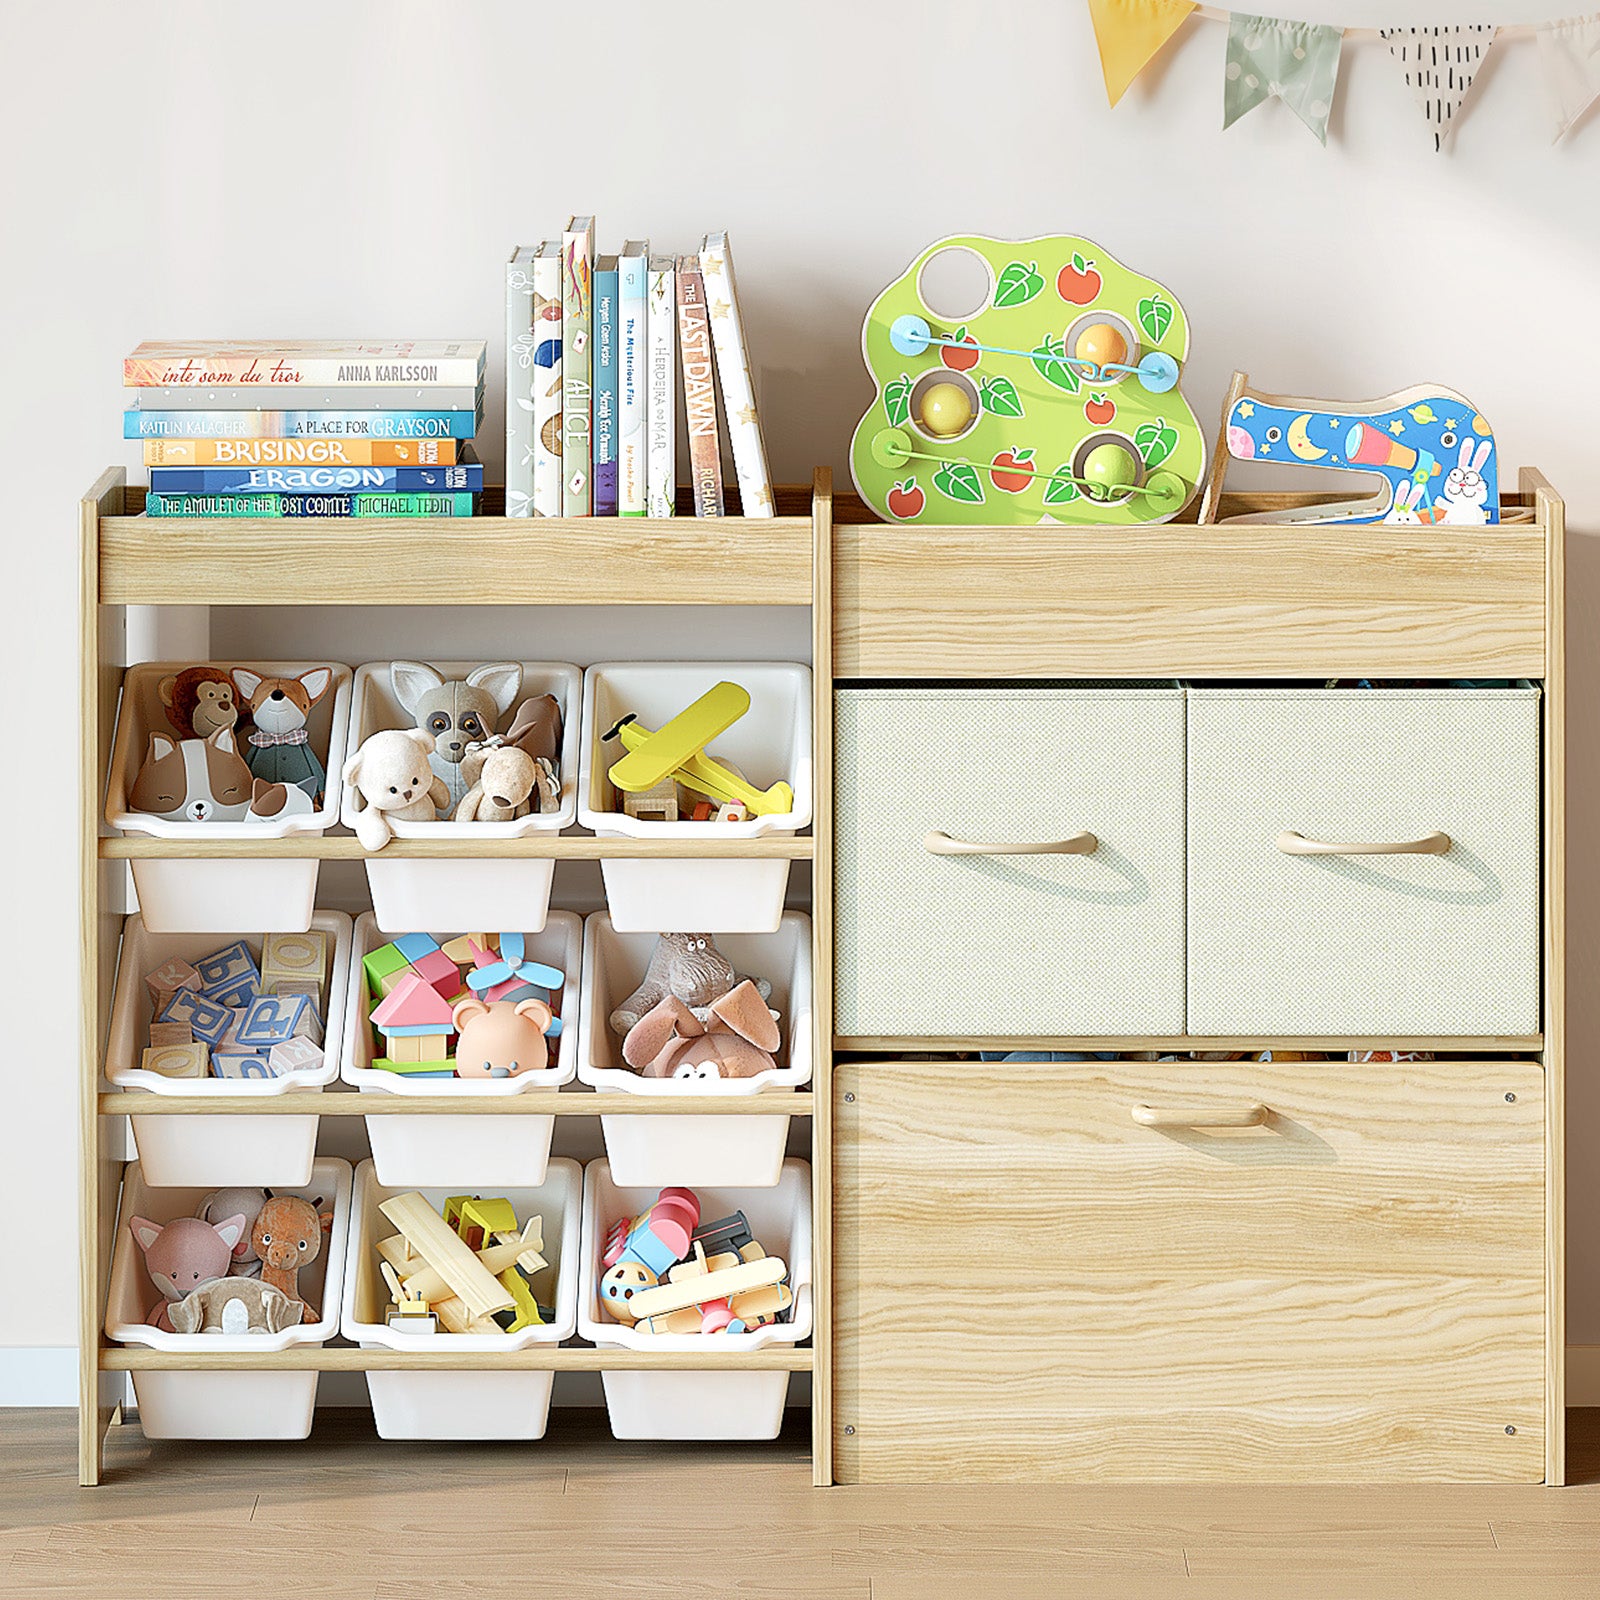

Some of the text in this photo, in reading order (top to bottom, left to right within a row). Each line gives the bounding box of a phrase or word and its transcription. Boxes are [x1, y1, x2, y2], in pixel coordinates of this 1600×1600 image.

[162, 359, 304, 383] inte som du tror
[626, 337, 634, 386] Mysterious
[680, 284, 714, 436] THE LAST DAWN
[337, 365, 438, 382] ANNA KARLSSON
[653, 347, 670, 406] HERDEIRA
[565, 379, 591, 448] ALICE
[139, 421, 246, 434] KAITLIN KALAGHER
[295, 418, 450, 437] A PLACE FOR GRAYSON
[651, 422, 667, 453] MAR
[213, 440, 352, 464] BRISINGR
[160, 497, 180, 514] THE
[184, 497, 234, 516] AMULET
[236, 499, 249, 513] OF
[274, 497, 304, 514] LOST
[357, 497, 413, 516] MICHAEL
